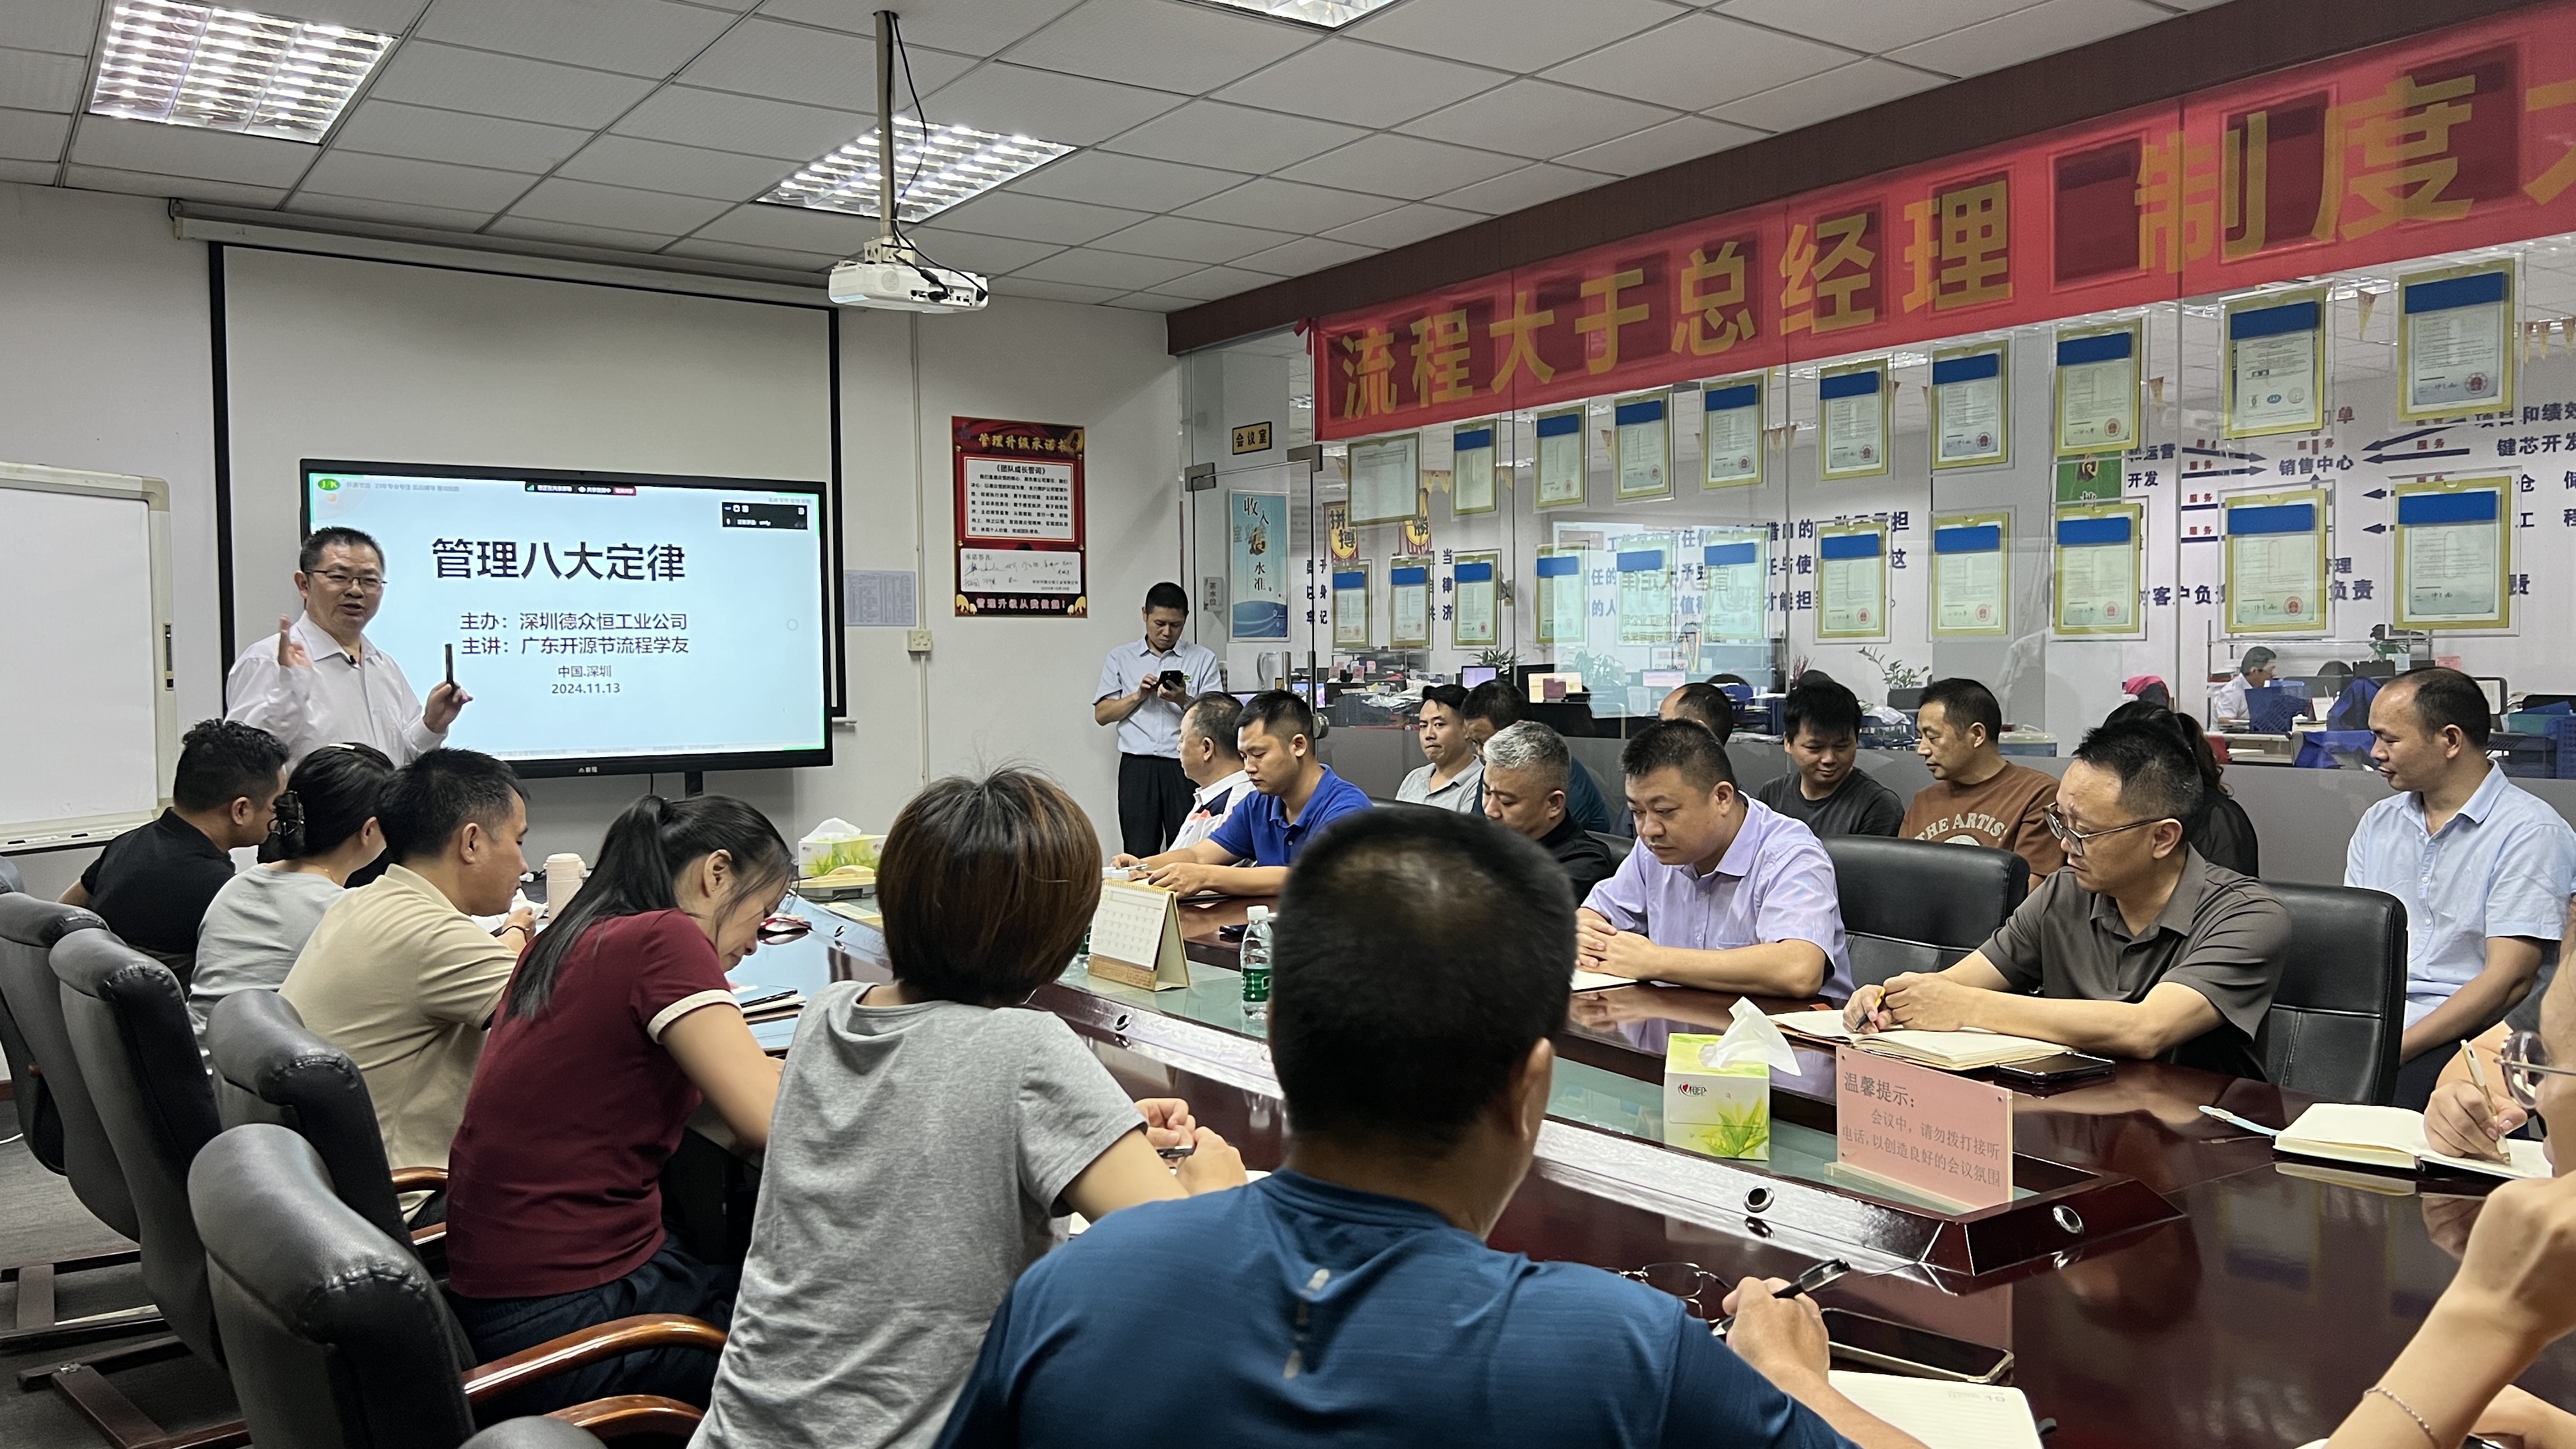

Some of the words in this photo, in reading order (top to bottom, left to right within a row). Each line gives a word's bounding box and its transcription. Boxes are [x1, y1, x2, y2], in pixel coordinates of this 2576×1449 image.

[1342, 180, 2013, 420] 流程大于总经理
[979, 433, 1068, 452] 管理升级承诺书
[1236, 429, 1267, 447] 会议室
[2279, 454, 2354, 475] 销售中心
[2128, 471, 2158, 488] 开发
[432, 538, 686, 581] 管理八大定律
[460, 612, 687, 631] 主办：深圳德众恒工业公司
[461, 636, 689, 655] 主讲：广东开源节流程学友
[557, 664, 611, 678] 中国.深圳
[551, 682, 620, 694] 2024.11.13
[1914, 818, 1949, 841] THE
[1952, 812, 2007, 841] ARTIS
[1844, 1071, 1915, 1109] 温馨提示：
[1871, 1107, 2000, 1161] 会议中，请勿拨打接听
[1842, 1124, 2000, 1188] 电话，以创造良好的会议氛围
